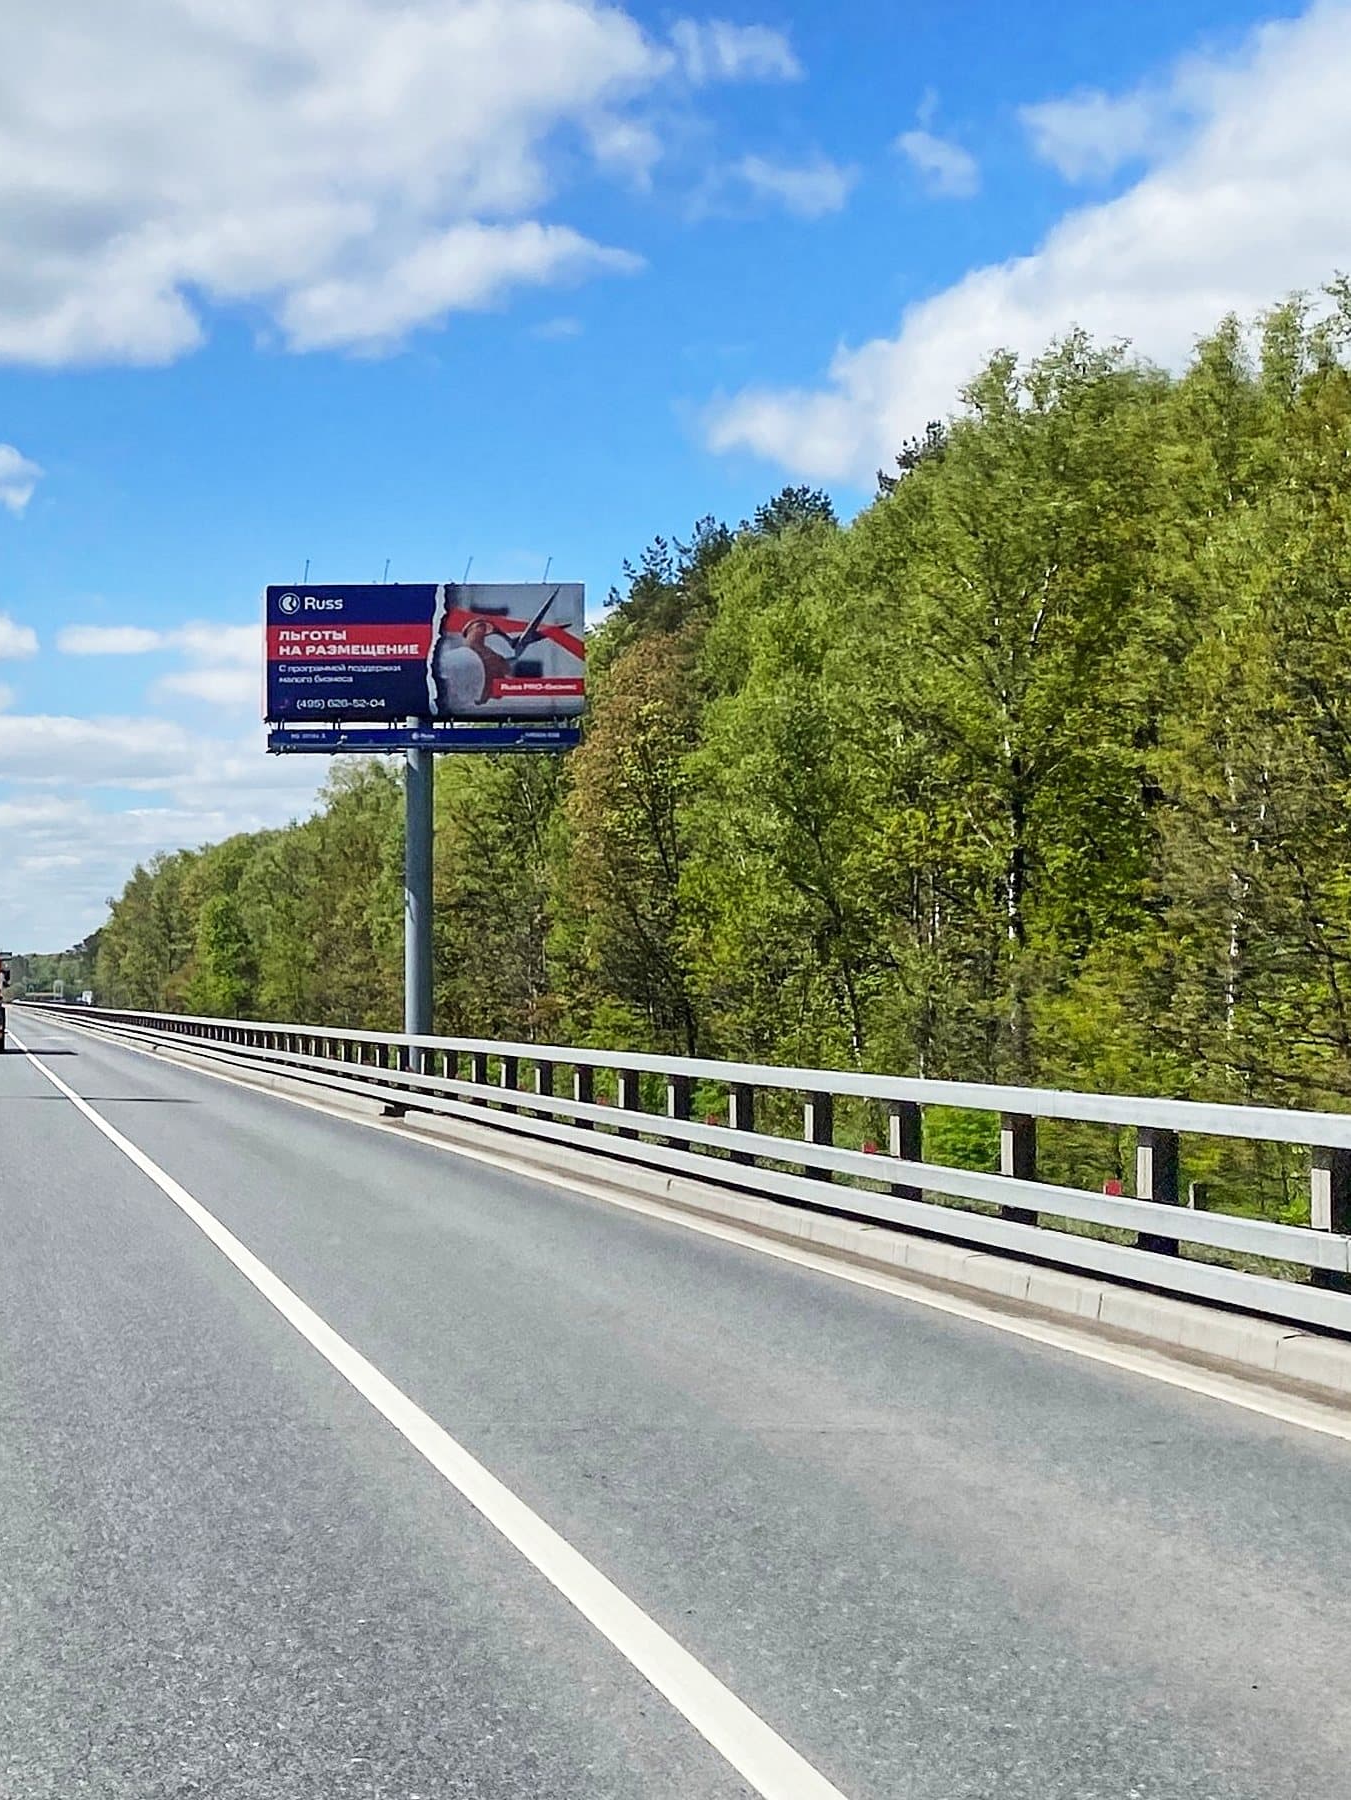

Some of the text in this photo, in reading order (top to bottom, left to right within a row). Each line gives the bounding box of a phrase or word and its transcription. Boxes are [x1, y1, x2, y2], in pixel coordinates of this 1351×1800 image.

[304, 596, 344, 610] Russ
[278, 630, 347, 641] ЛЬГОТЫ
[278, 643, 419, 656] НА РАЗМЕЩЕНИЕ
